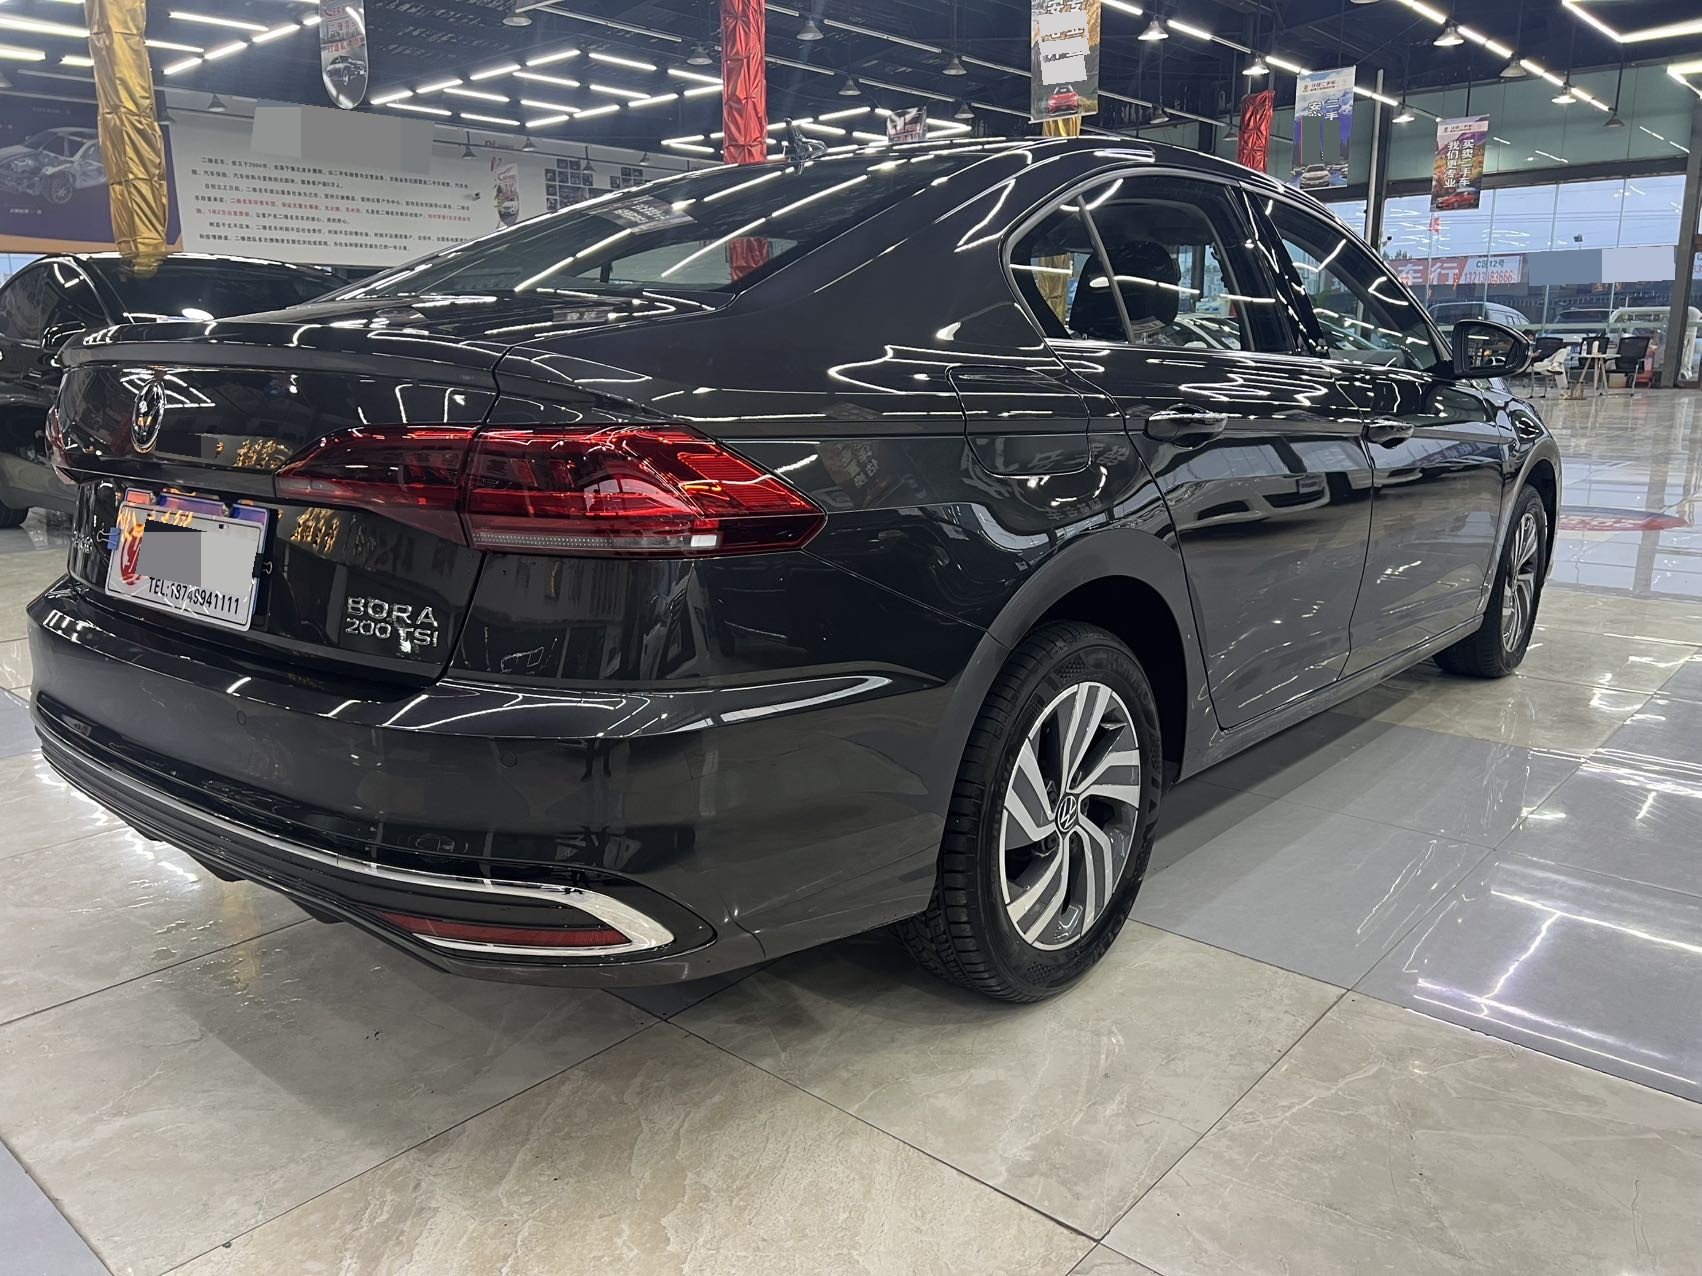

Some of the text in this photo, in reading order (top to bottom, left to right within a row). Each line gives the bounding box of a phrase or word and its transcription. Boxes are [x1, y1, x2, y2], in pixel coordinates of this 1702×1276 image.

[1443, 140, 1460, 188] 我们更专业
[1458, 139, 1475, 187] 买卖二手车
[347, 596, 439, 627] BORA
[345, 617, 439, 649] 200 TSI
